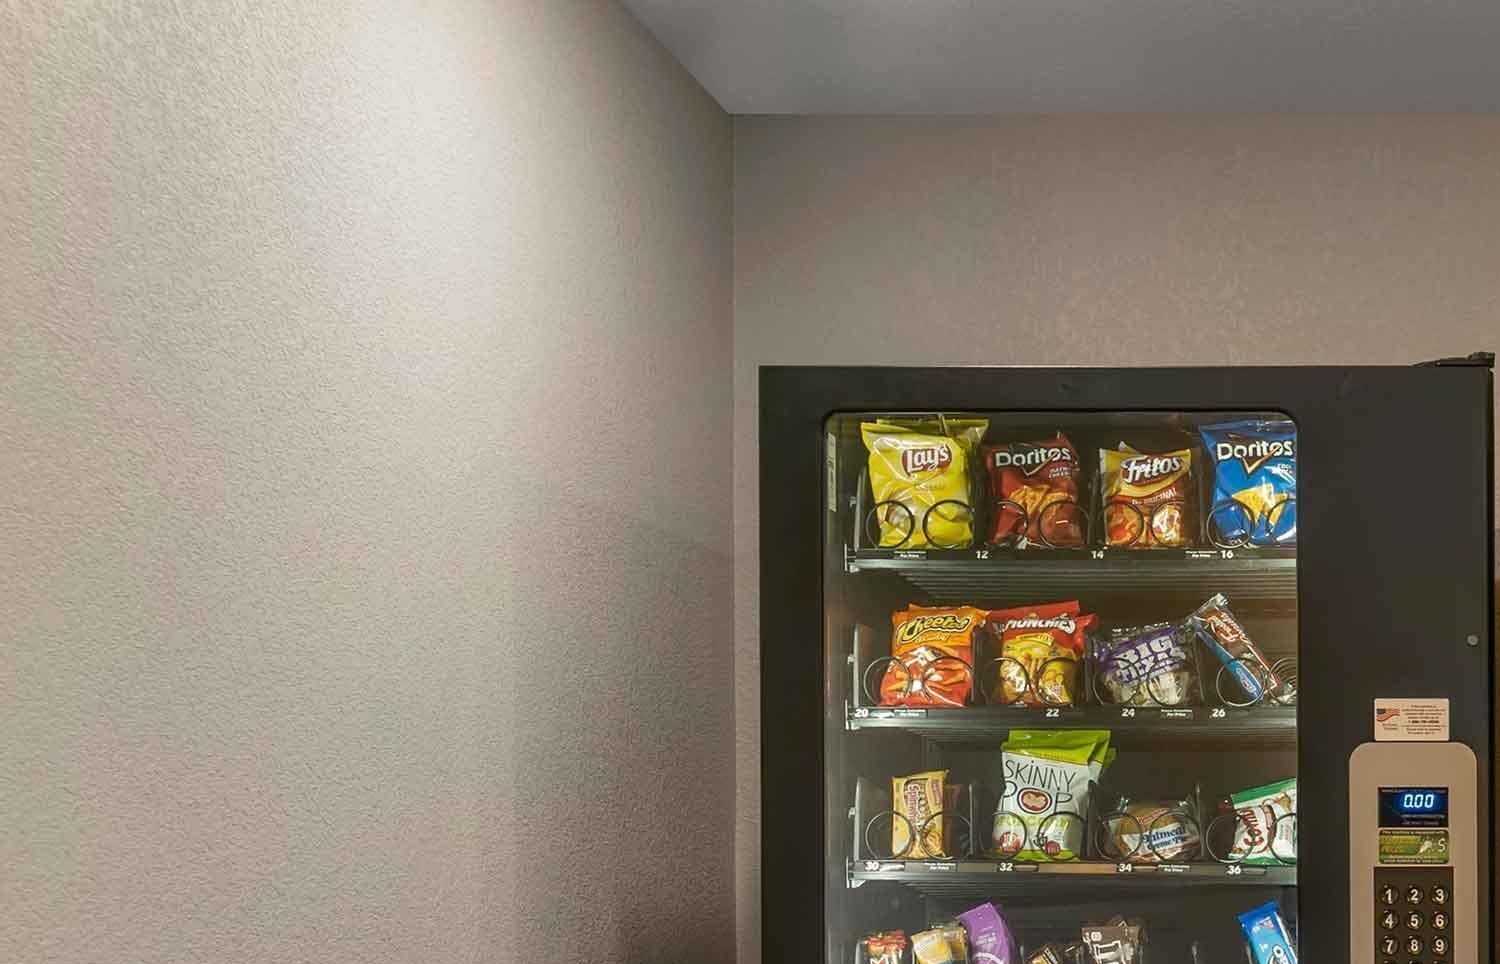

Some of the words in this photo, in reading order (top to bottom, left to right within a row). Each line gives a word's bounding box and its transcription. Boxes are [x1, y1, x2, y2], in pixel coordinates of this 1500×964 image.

[1217, 440, 1293, 460] Doritos
[995, 447, 1071, 467] Doritos
[1120, 455, 1181, 484] Fritos
[975, 550, 989, 560] 12
[1091, 551, 1104, 559] 14
[1220, 551, 1234, 559] 16
[1115, 636, 1172, 664] BIG
[855, 709, 869, 718] 20
[1046, 708, 1059, 717] 22
[1121, 708, 1135, 717] 24
[1212, 709, 1226, 717] 26
[1002, 760, 1077, 793] SKINNY
[1000, 781, 1073, 815] POP
[1404, 794, 1434, 809] 0.00
[865, 862, 880, 871] 30
[1000, 863, 1013, 872] 32
[1119, 864, 1132, 873] 34
[1227, 866, 1241, 875] 36
[1385, 889, 1394, 903] 1
[1410, 889, 1419, 903] 2
[1435, 889, 1444, 903] 3
[1385, 914, 1394, 928] 4
[1410, 914, 1419, 928] 5
[1435, 914, 1444, 928] 6
[1385, 939, 1394, 953] 7
[1410, 939, 1419, 953] 8
[1435, 939, 1444, 953] 9
